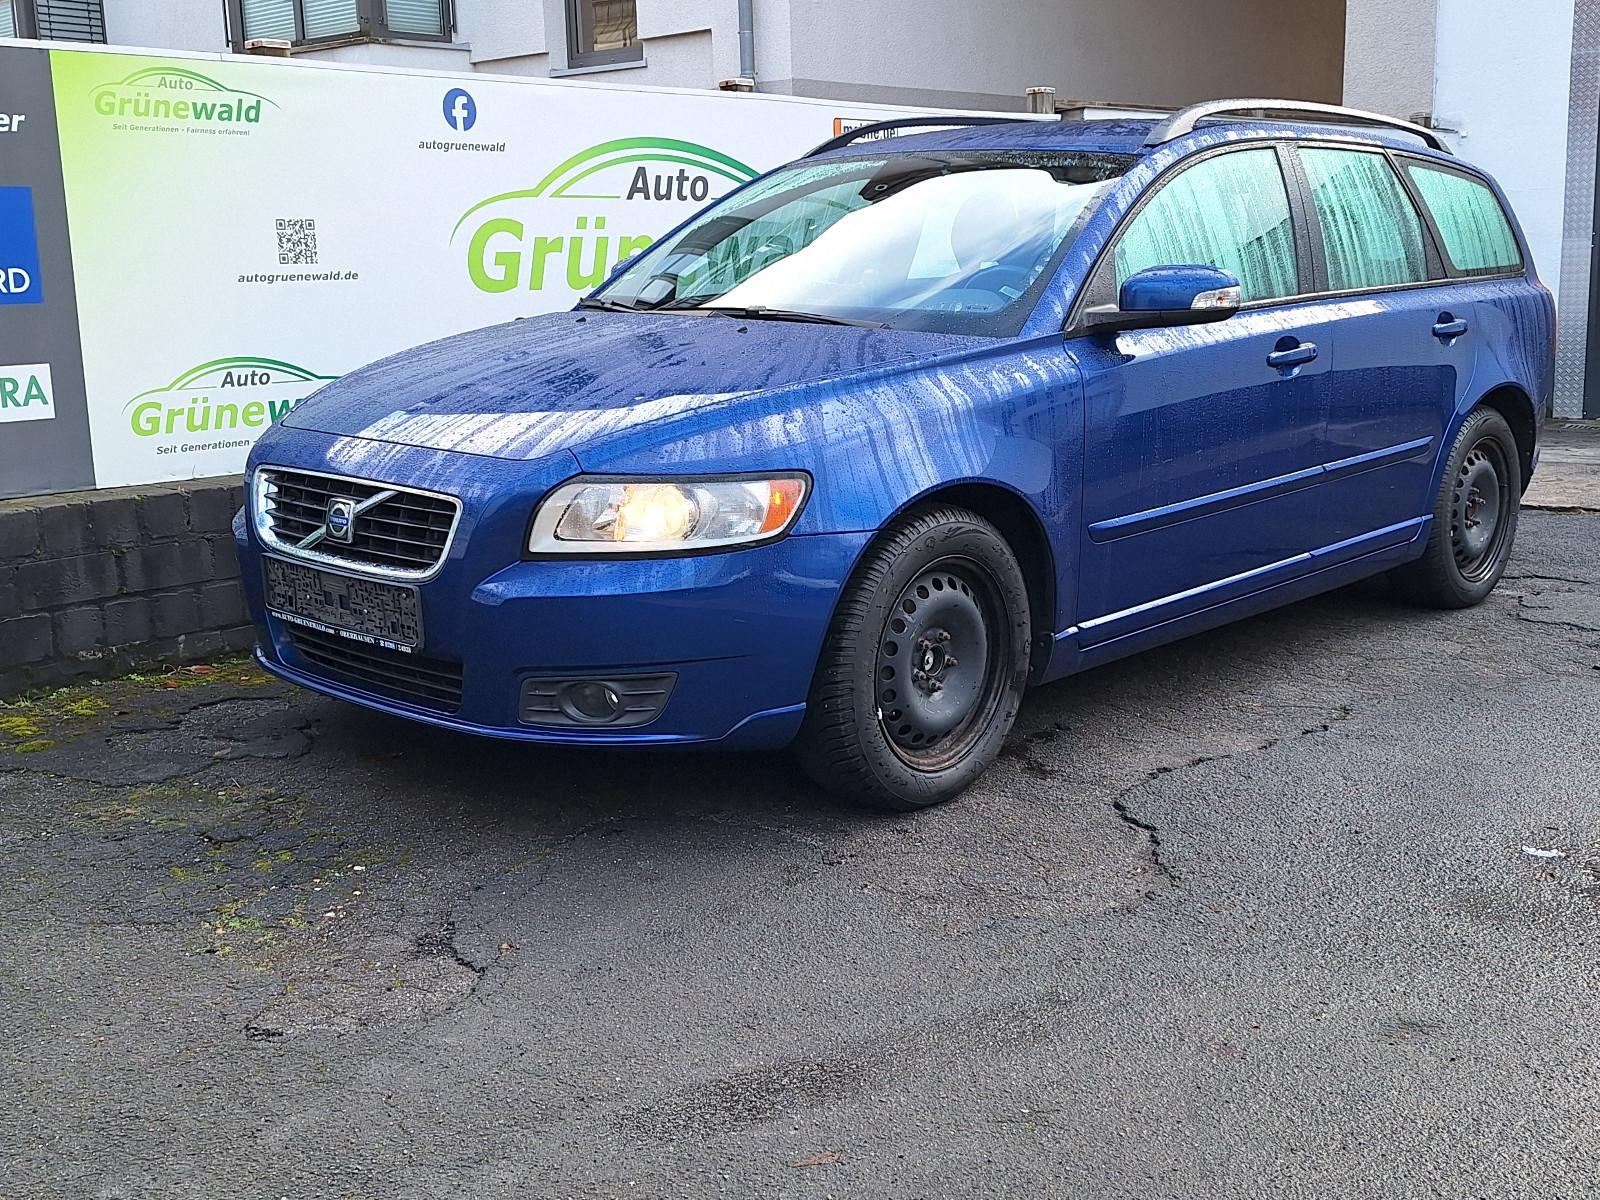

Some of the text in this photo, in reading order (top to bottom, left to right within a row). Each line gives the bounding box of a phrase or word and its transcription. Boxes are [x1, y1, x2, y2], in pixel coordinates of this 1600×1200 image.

[157, 76, 194, 91] Auto
[94, 91, 262, 123] Grünewald
[112, 123, 128, 131] Seit
[129, 124, 180, 133] Generationen
[186, 127, 217, 136] Fairness
[418, 140, 506, 152] autogruenewald
[626, 166, 709, 201] Auto
[237, 271, 359, 284] autogruenewald.de
[220, 370, 271, 388] Auto
[0, 375, 49, 408] RA
[156, 446, 178, 455] Seit
[180, 439, 250, 453] Generationen
